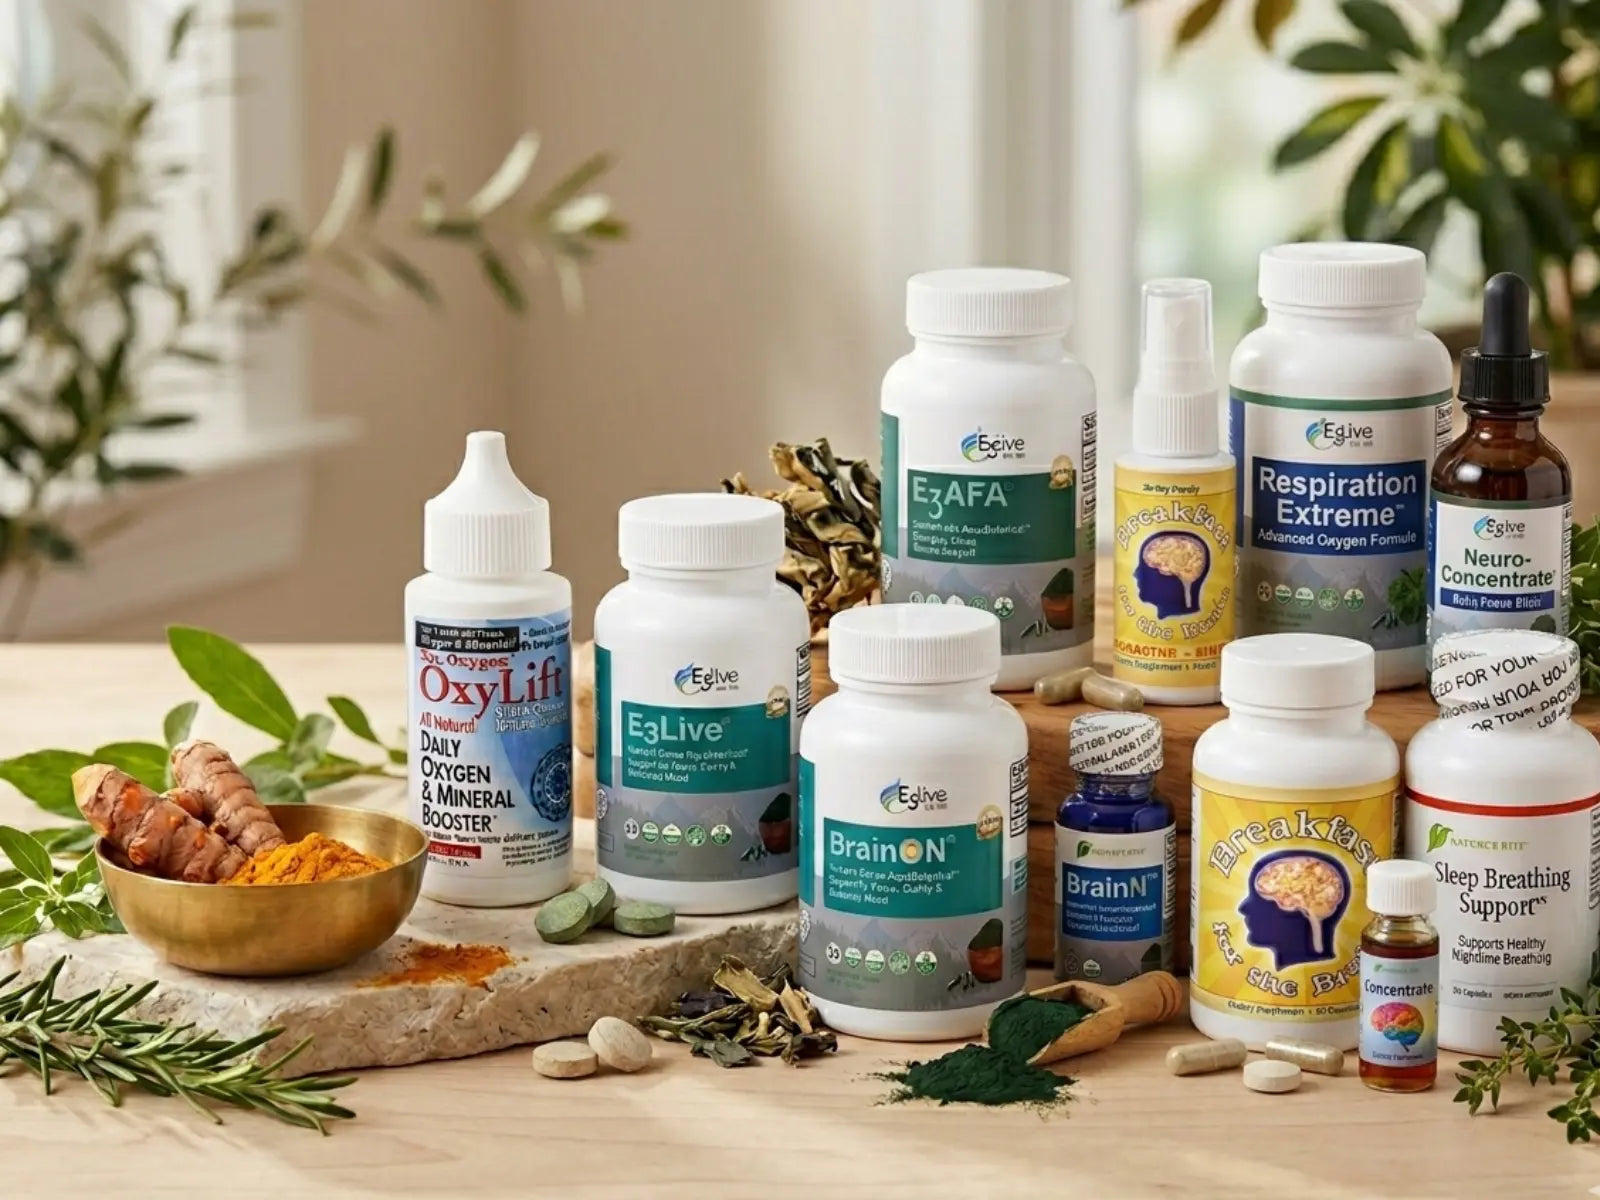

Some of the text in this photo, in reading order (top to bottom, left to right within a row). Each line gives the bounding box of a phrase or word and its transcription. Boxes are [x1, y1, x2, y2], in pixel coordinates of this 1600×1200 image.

[1259, 466, 1416, 501] Respiration
[1258, 528, 1313, 546] Advanced
[1317, 533, 1367, 551] Oxygen
[1464, 548, 1531, 567] Neuro-
[1441, 564, 1554, 588] Concentrate
[419, 655, 563, 720] OxyLift
[1456, 668, 1488, 689] FOR
[422, 780, 433, 803] &
[1435, 861, 1571, 892] Sleep Breathing
[1458, 934, 1547, 951] Supports Healthy
[1364, 979, 1434, 997] Concentrate
